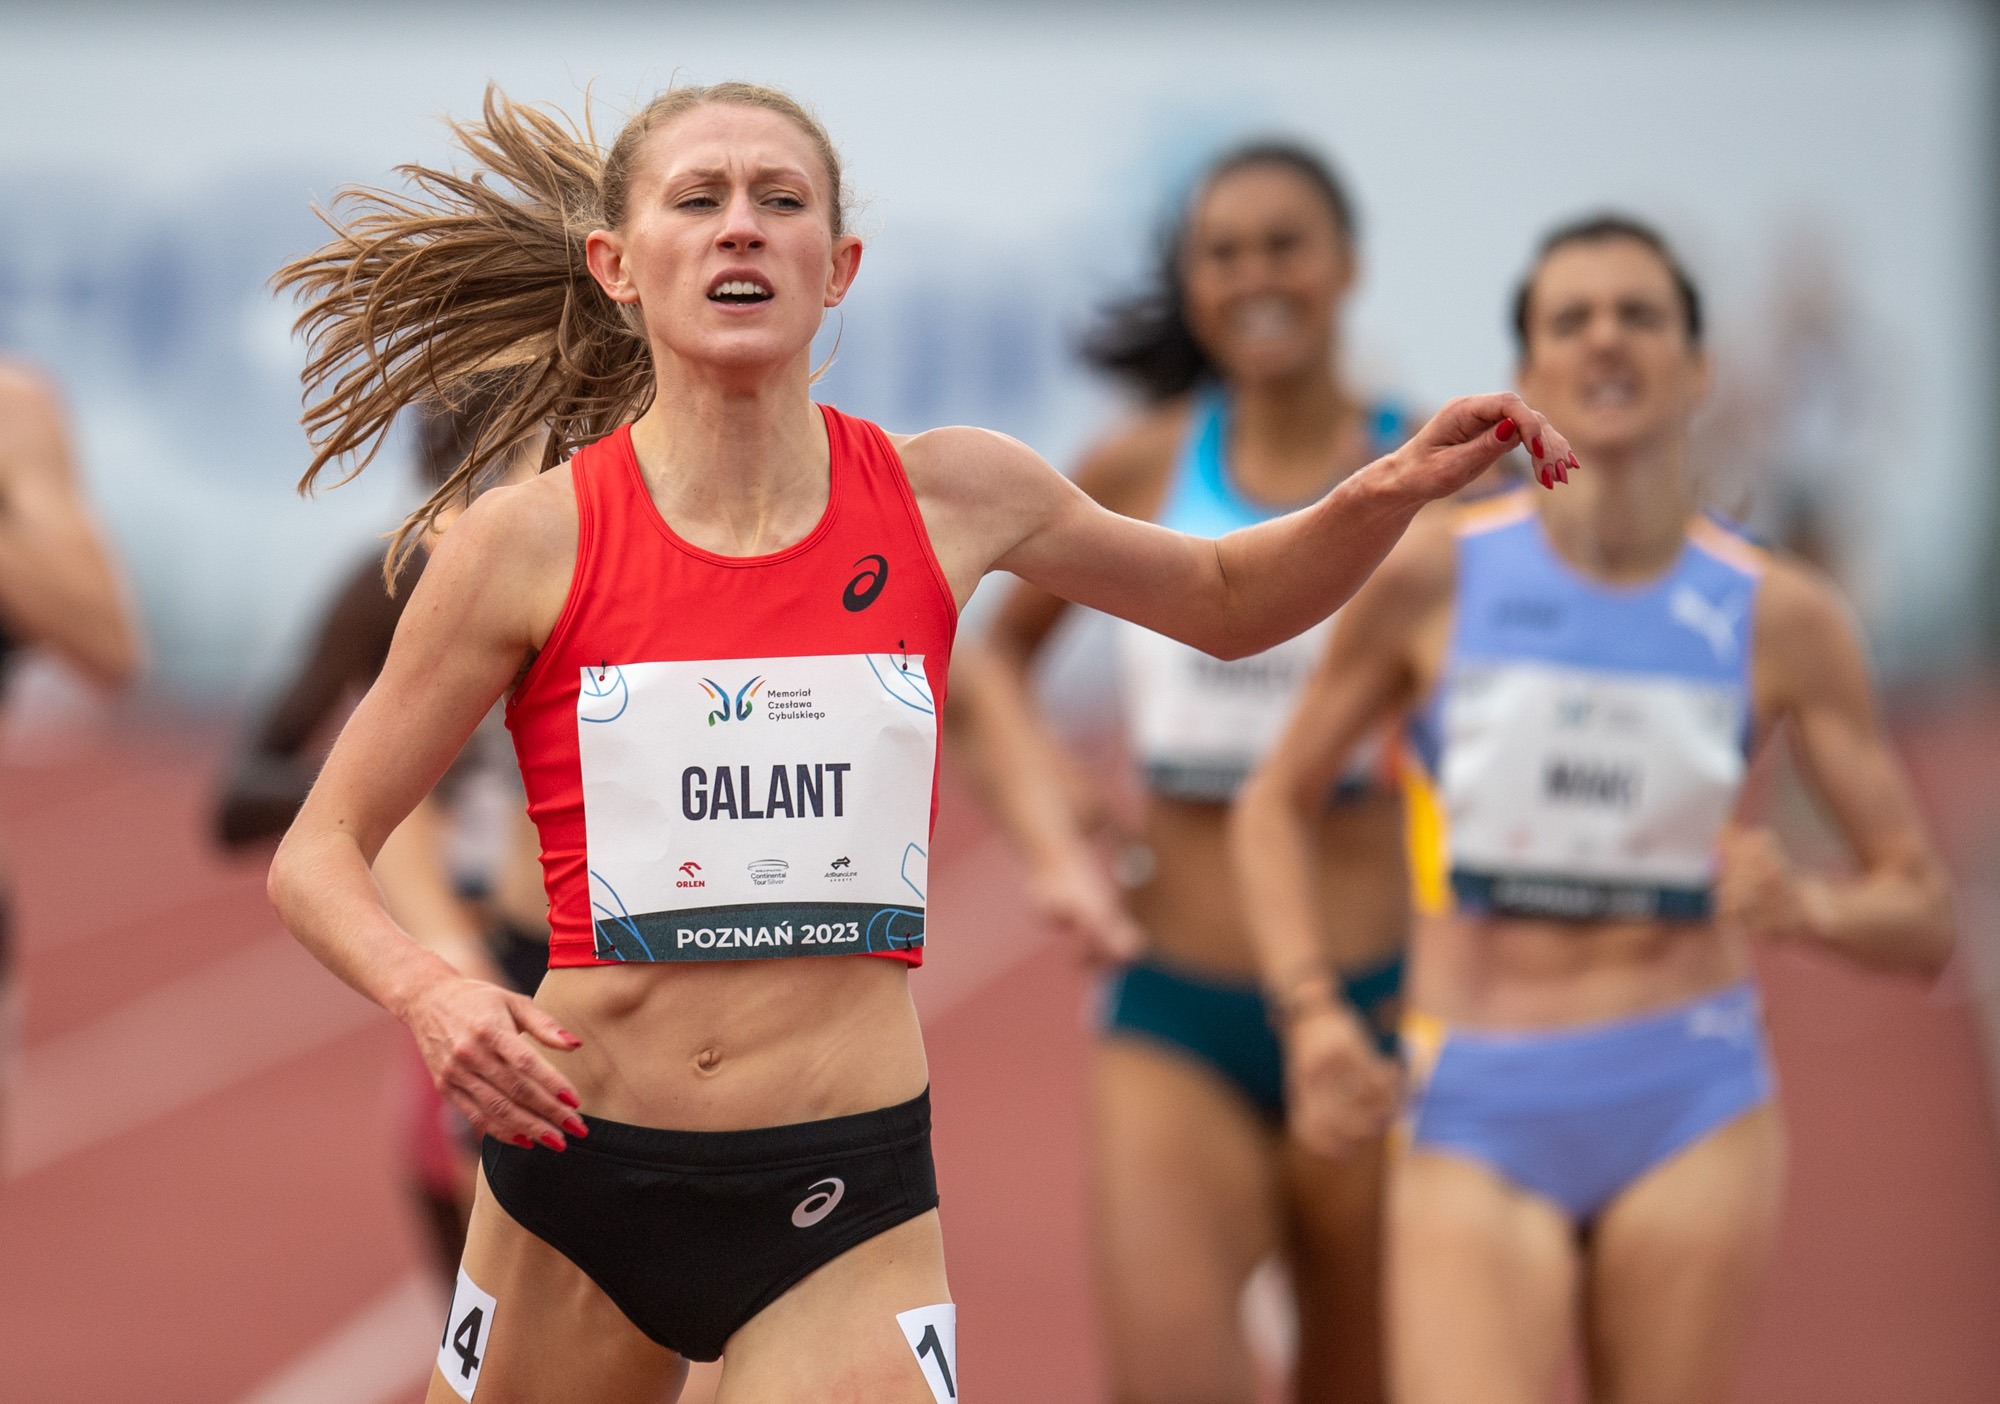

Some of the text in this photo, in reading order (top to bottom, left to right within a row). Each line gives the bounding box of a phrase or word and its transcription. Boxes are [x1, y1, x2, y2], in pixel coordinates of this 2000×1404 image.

[767, 688, 811, 698] Memoriał
[767, 700, 812, 709] Czesława
[768, 710, 826, 722] Cybulskiego
[681, 763, 851, 821] GALANT
[750, 872, 787, 880] Continental
[676, 880, 706, 888] ORLEN
[676, 920, 860, 949] POZNAŃ 2023
